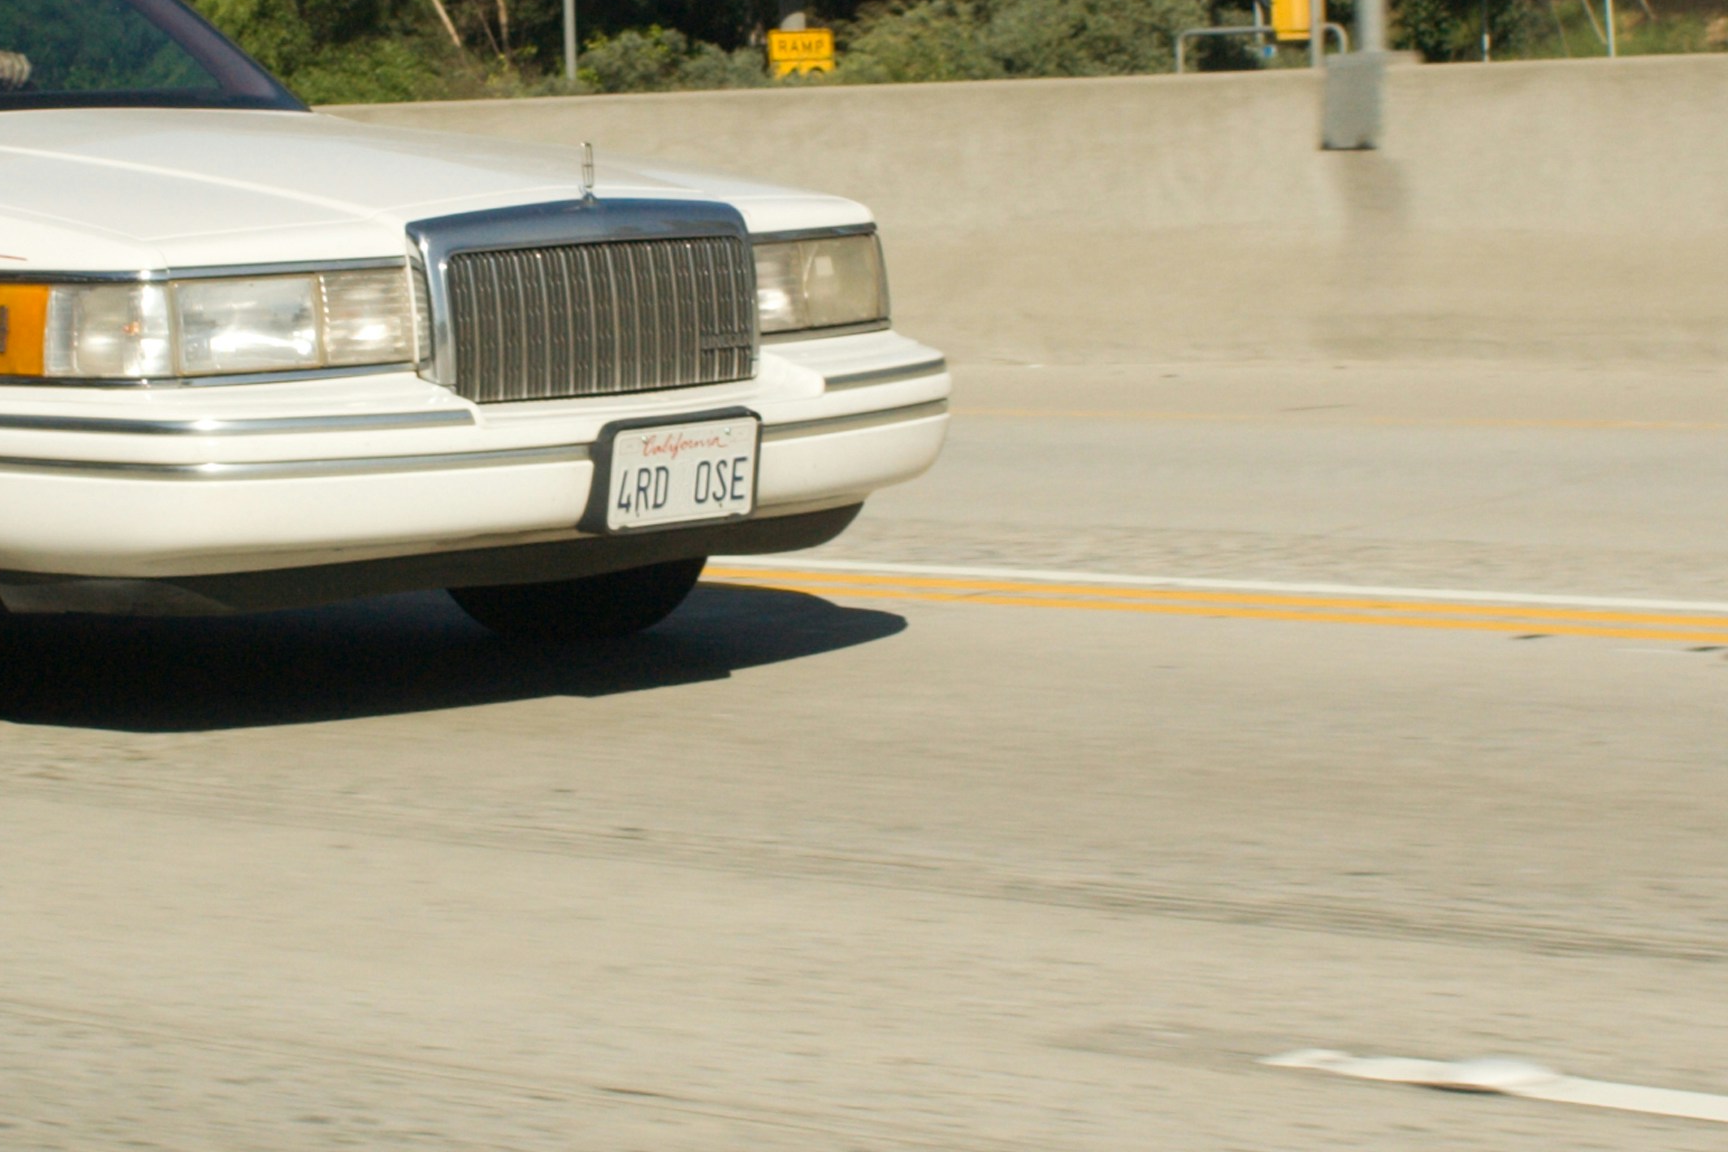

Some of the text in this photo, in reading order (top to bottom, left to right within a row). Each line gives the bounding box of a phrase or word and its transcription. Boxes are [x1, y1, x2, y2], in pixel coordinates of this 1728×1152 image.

[778, 39, 824, 54] RAMP
[642, 432, 728, 460] California
[617, 466, 669, 514] 4RD
